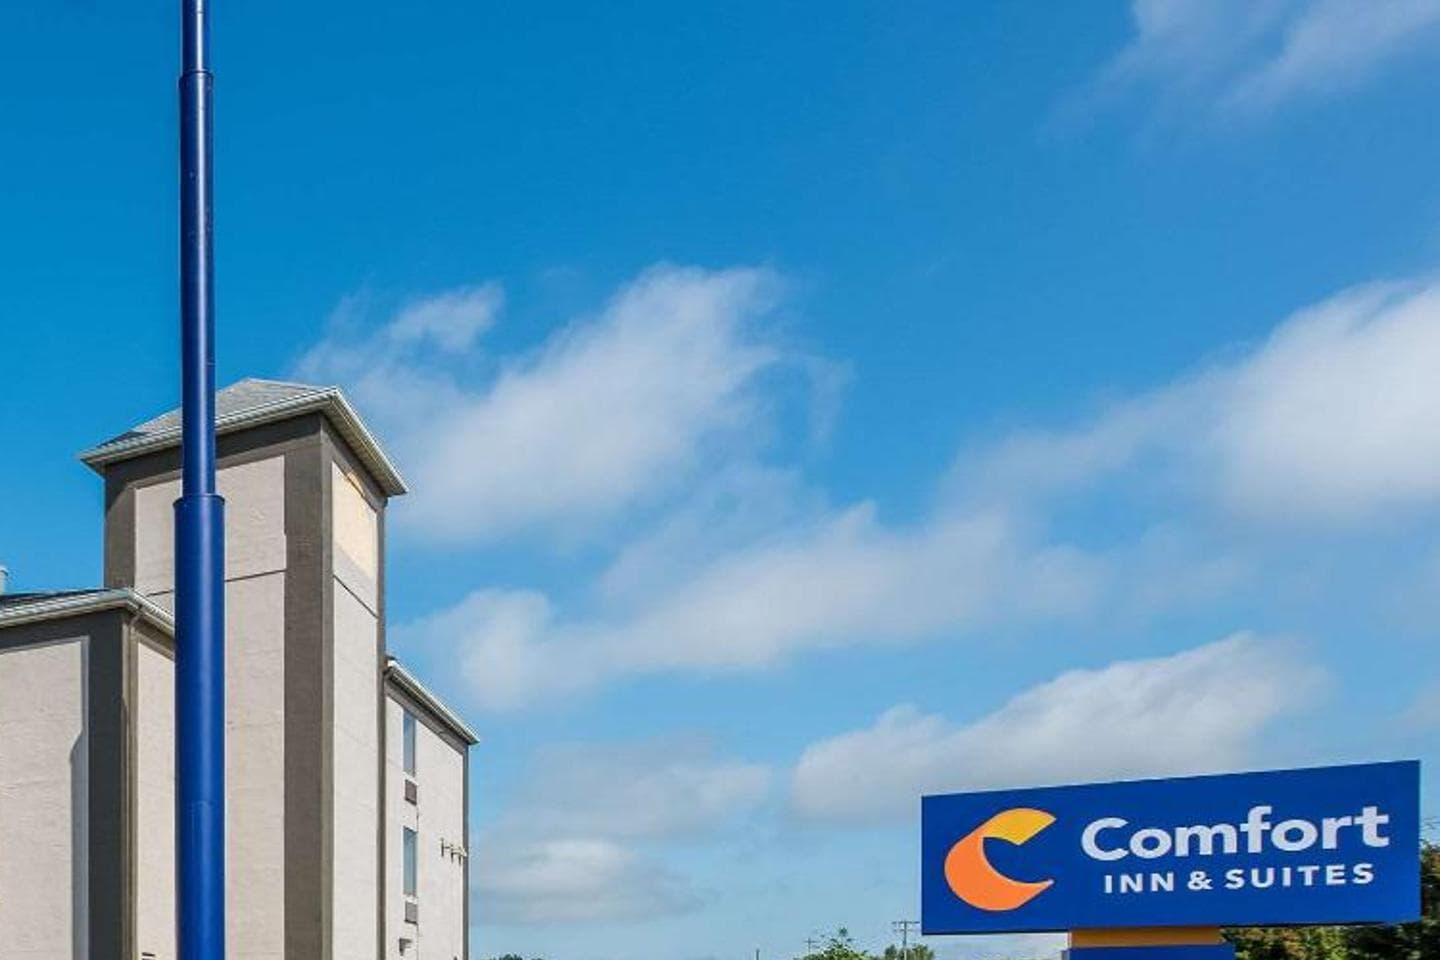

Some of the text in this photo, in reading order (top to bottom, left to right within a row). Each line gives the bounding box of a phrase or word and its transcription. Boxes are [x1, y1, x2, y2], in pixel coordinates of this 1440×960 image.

[1081, 805, 1390, 861] Comfort
[1104, 863, 1374, 893] INN & SUITES
